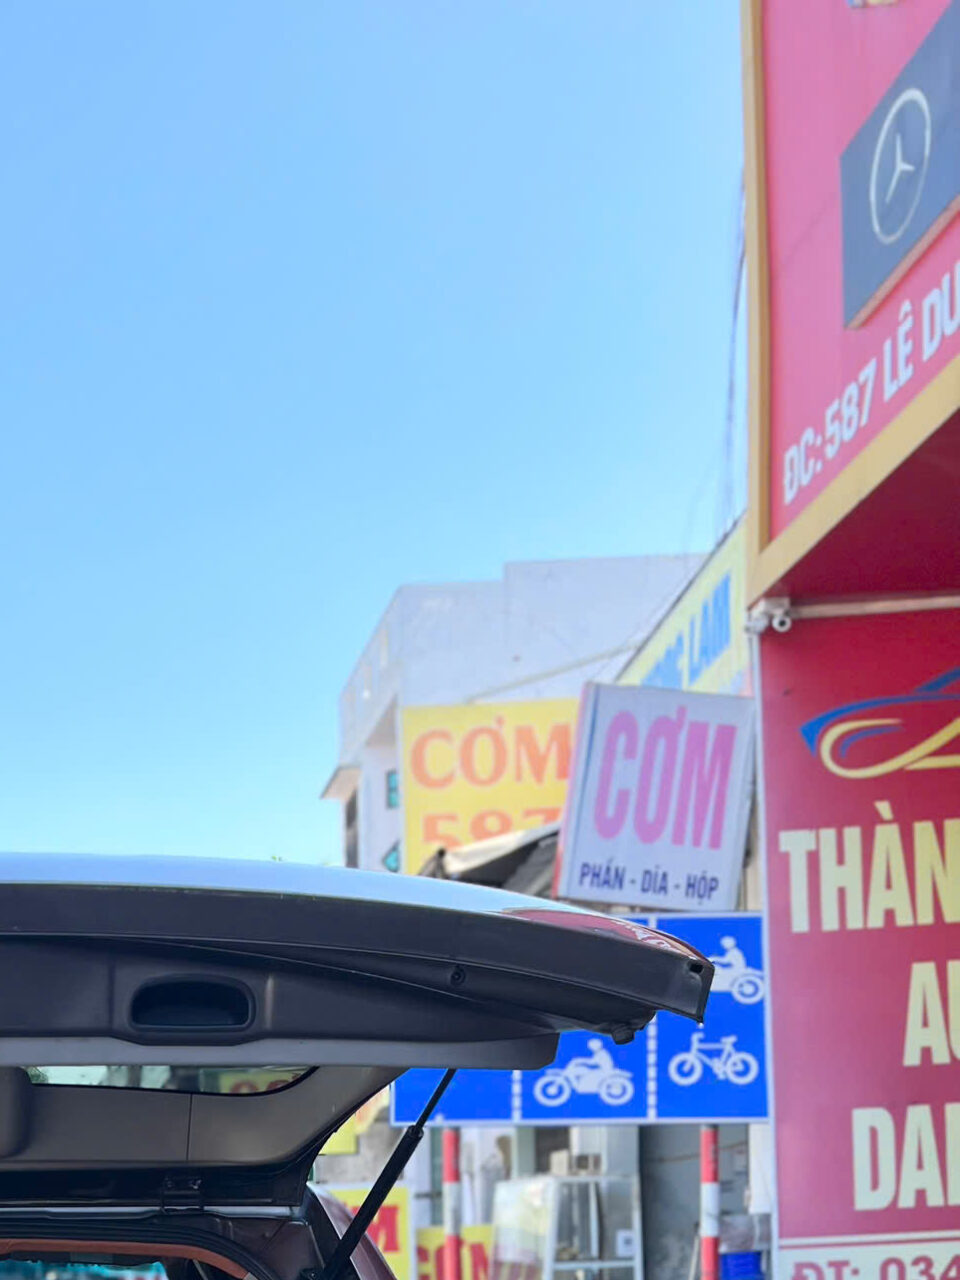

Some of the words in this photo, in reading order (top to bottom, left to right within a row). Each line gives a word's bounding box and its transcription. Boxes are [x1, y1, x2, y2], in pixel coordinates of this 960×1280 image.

[883, 299, 914, 403] LÊ
[411, 716, 572, 790] CƠM
[593, 704, 739, 850] CƠM
[778, 800, 960, 934] THÀN
